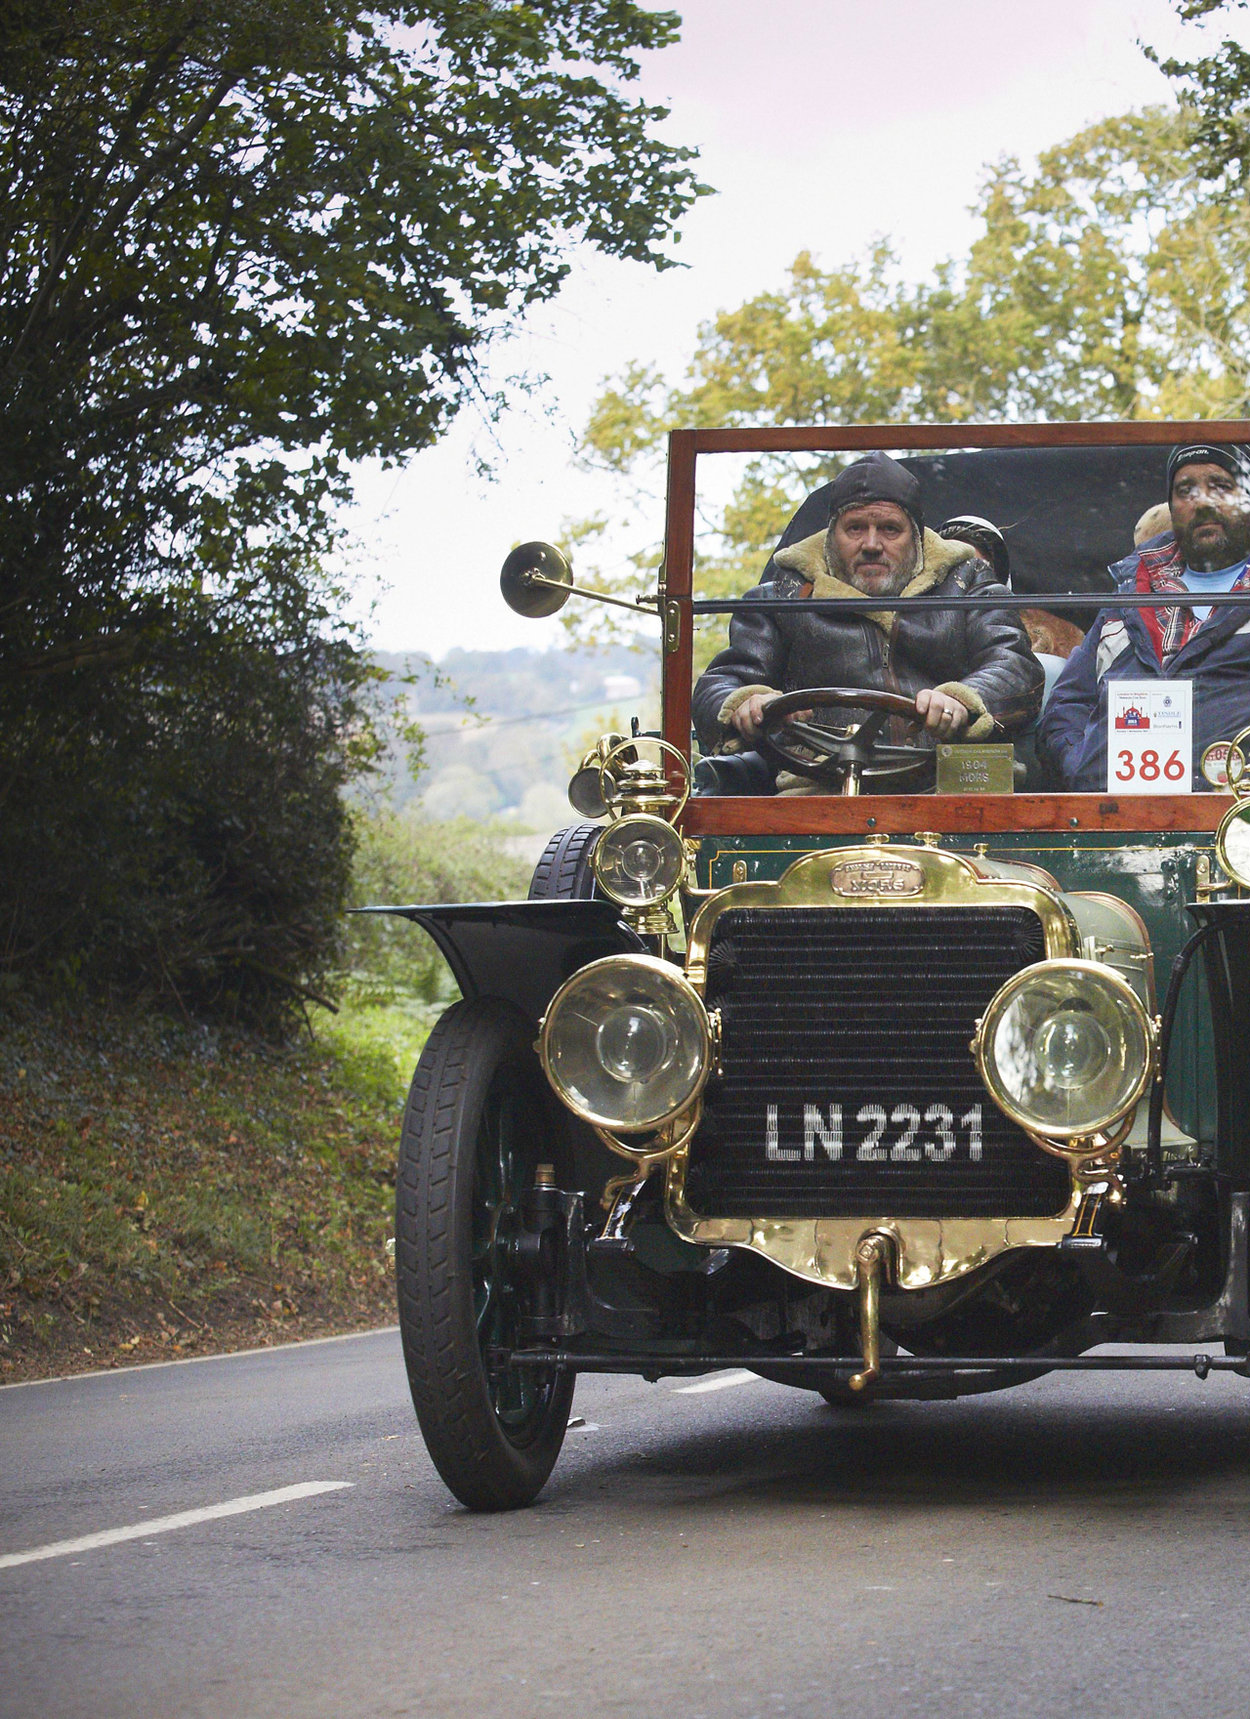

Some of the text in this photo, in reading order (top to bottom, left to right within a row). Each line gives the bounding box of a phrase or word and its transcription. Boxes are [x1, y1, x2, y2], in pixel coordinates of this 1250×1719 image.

[959, 772, 990, 783] MORS
[1115, 749, 1185, 781] 386
[766, 1103, 982, 1162] LN 2231
